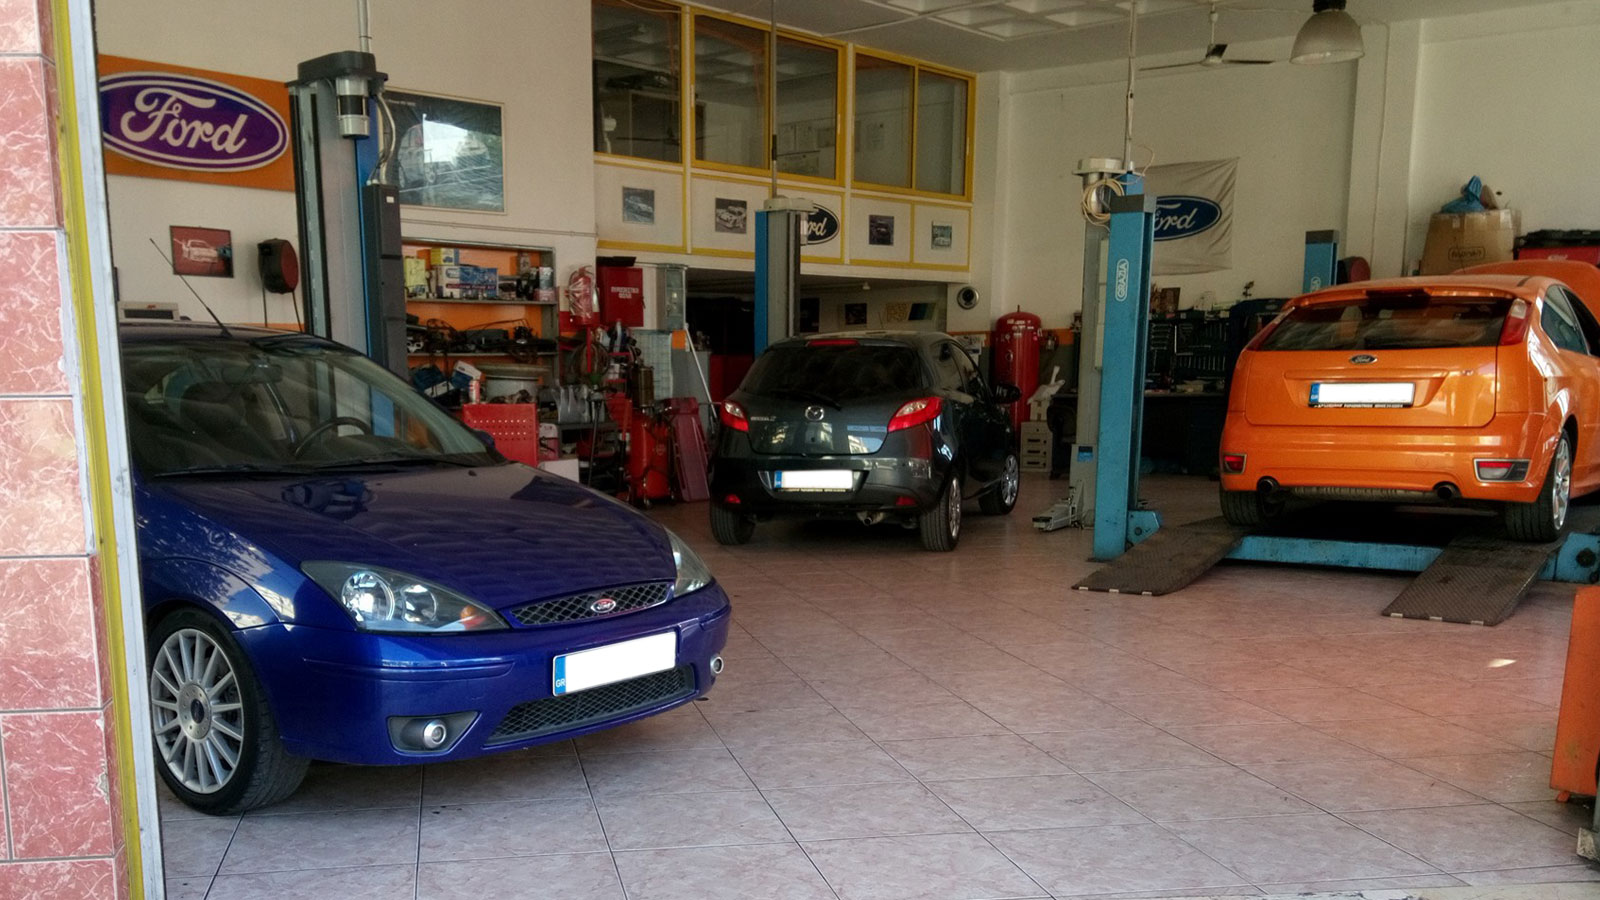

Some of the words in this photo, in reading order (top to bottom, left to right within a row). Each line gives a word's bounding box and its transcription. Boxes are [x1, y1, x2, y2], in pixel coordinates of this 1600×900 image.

[120, 86, 249, 155] Ford
[1118, 262, 1129, 298] GRAZIA
[555, 678, 566, 688] GR
